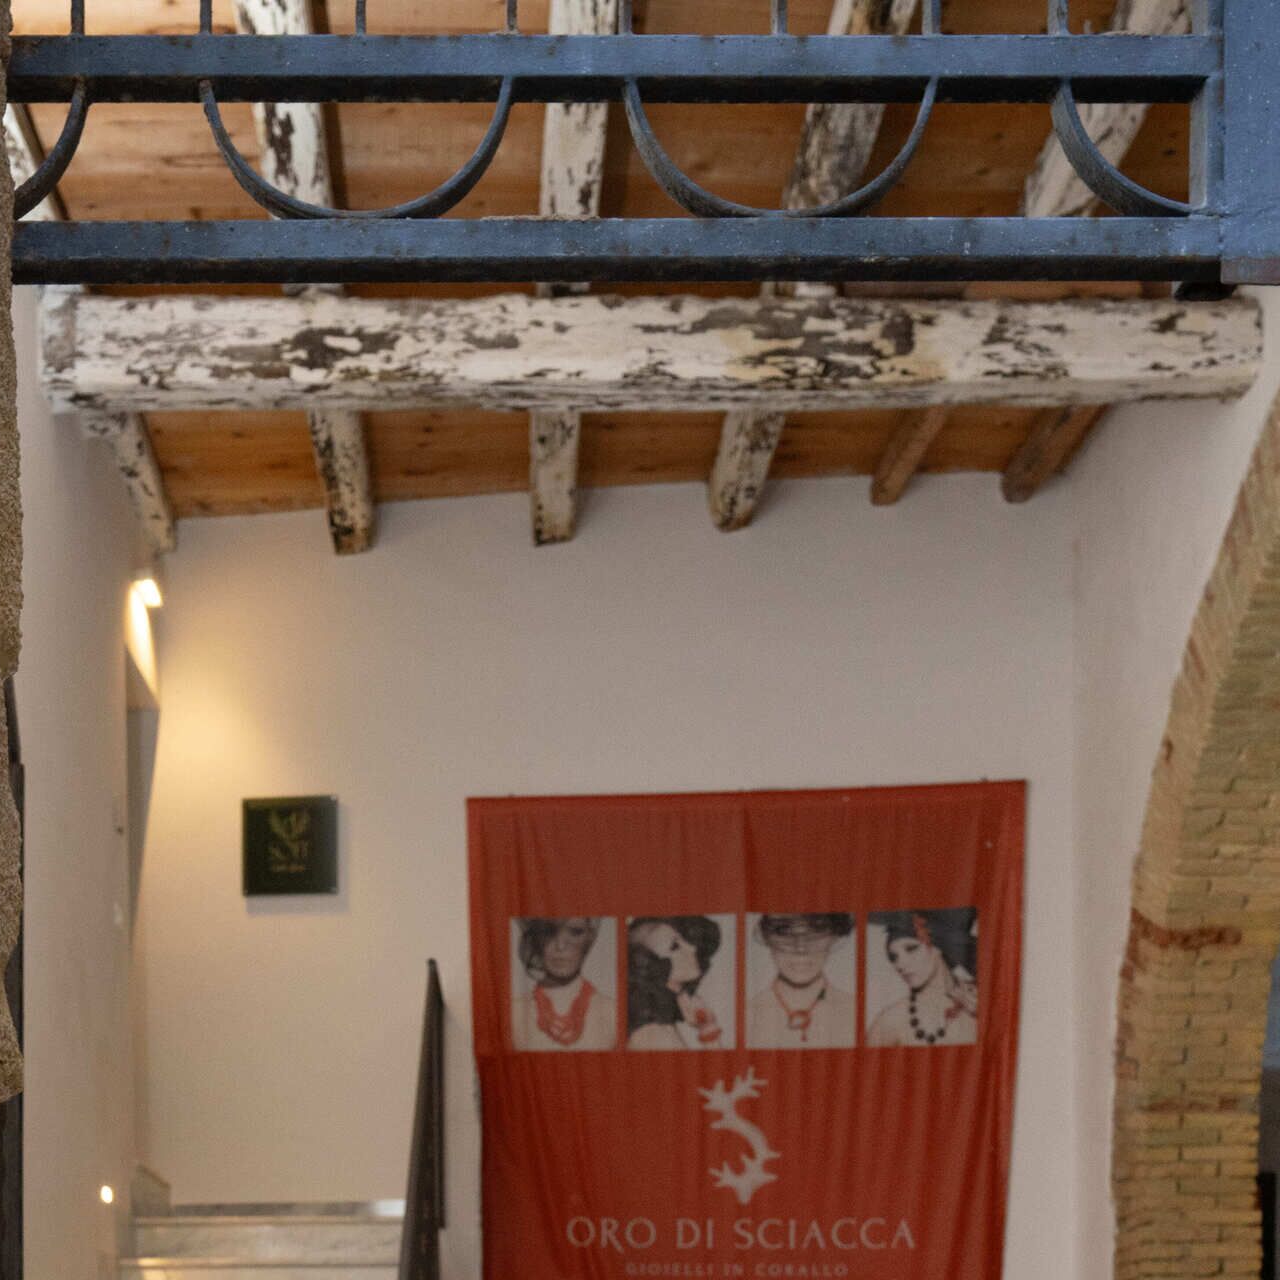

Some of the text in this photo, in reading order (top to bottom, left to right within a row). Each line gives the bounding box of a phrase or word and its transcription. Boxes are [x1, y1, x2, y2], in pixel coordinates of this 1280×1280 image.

[565, 1215, 915, 1252] ORO DI SCIACCA
[625, 1261, 849, 1278] GIOIELLI IN CORALLO
